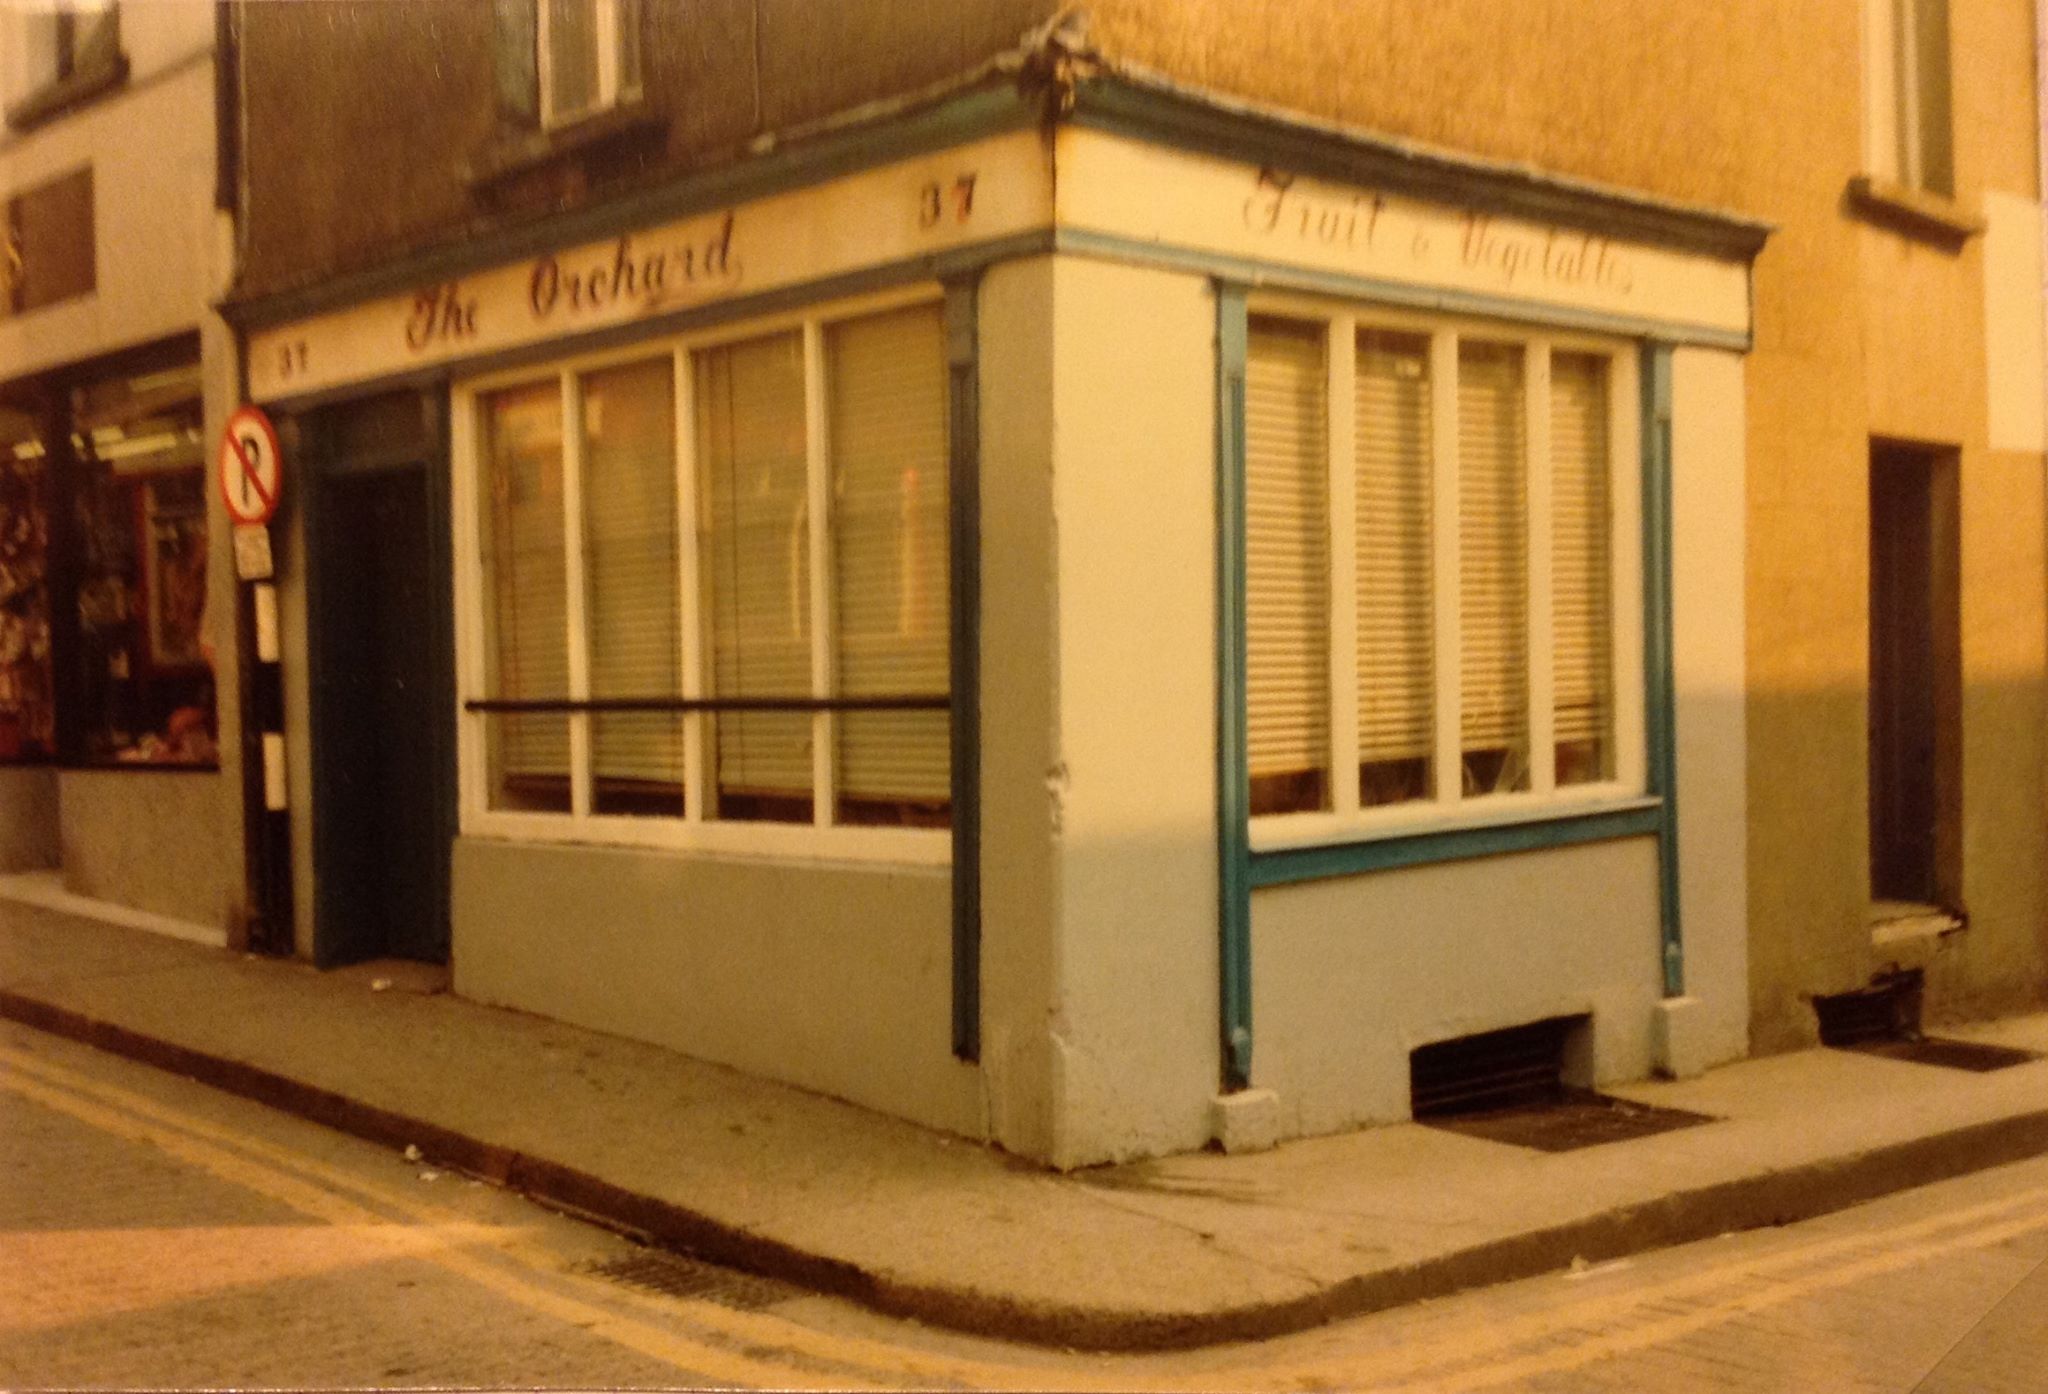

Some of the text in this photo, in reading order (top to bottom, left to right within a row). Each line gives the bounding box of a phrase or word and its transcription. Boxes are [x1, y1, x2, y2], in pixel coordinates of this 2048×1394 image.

[405, 281, 477, 352] The
[527, 209, 743, 318] Orchard
[919, 172, 978, 230] 37
[1242, 167, 1386, 247] Fruit
